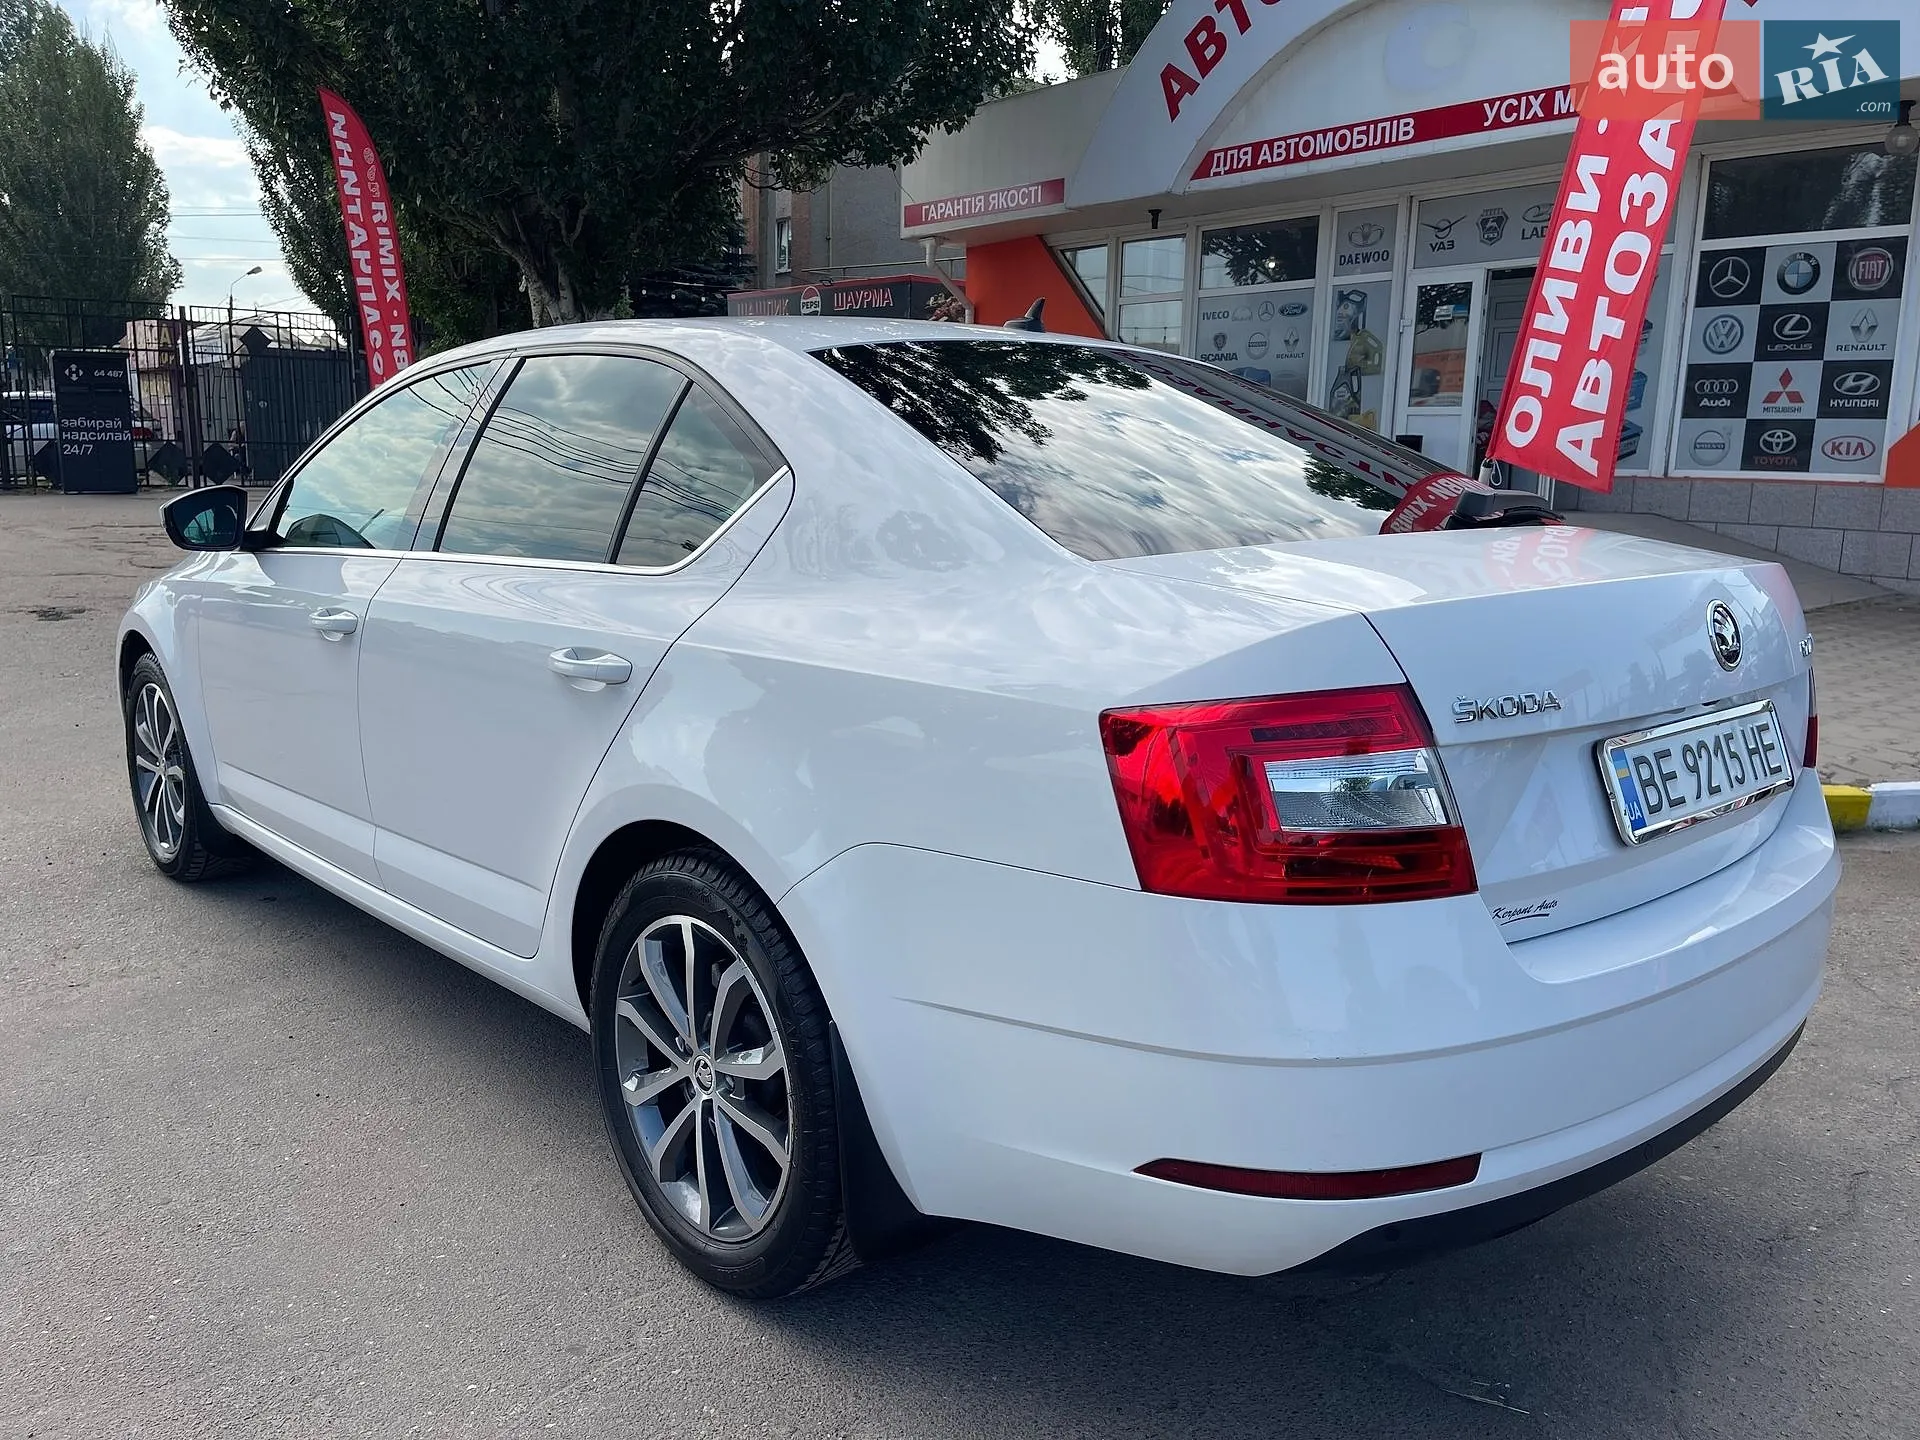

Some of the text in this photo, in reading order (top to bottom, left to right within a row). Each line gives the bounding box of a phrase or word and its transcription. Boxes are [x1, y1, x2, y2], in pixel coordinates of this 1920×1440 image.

[1160, 0, 1280, 122] АВТ
[1210, 145, 1253, 176] ДЛЯ
[1257, 118, 1415, 164] АВТОМОБІЛІВ
[1483, 94, 1544, 127] УСІХ
[922, 185, 1042, 222] ГАРАНТІЯ ЯКОСТІ
[1429, 240, 1455, 252] УАЗ
[1339, 250, 1389, 266] DAEWOO
[1858, 260, 1885, 279] FIAT
[834, 288, 894, 311] ШАУРМА
[1505, 154, 1609, 448] ОЛИВИ
[1202, 310, 1230, 320] IVECO
[1767, 343, 1813, 351] LEXUS
[1836, 343, 1887, 352] RENAULT
[1200, 353, 1239, 362] SCANIA
[1699, 398, 1731, 407] Audi
[1830, 399, 1879, 407] HYUNDAI
[1762, 406, 1802, 414] MITSUBISHI
[61, 417, 122, 430] забирай
[62, 428, 131, 441] надсилай
[63, 444, 94, 455] 24/7
[1830, 442, 1866, 456] KIA
[1753, 455, 1798, 465] TOYOTA
[1451, 690, 1562, 723] ŠKODA
[1633, 722, 1783, 814] BE 9215 HE
[1628, 801, 1643, 820] UA
